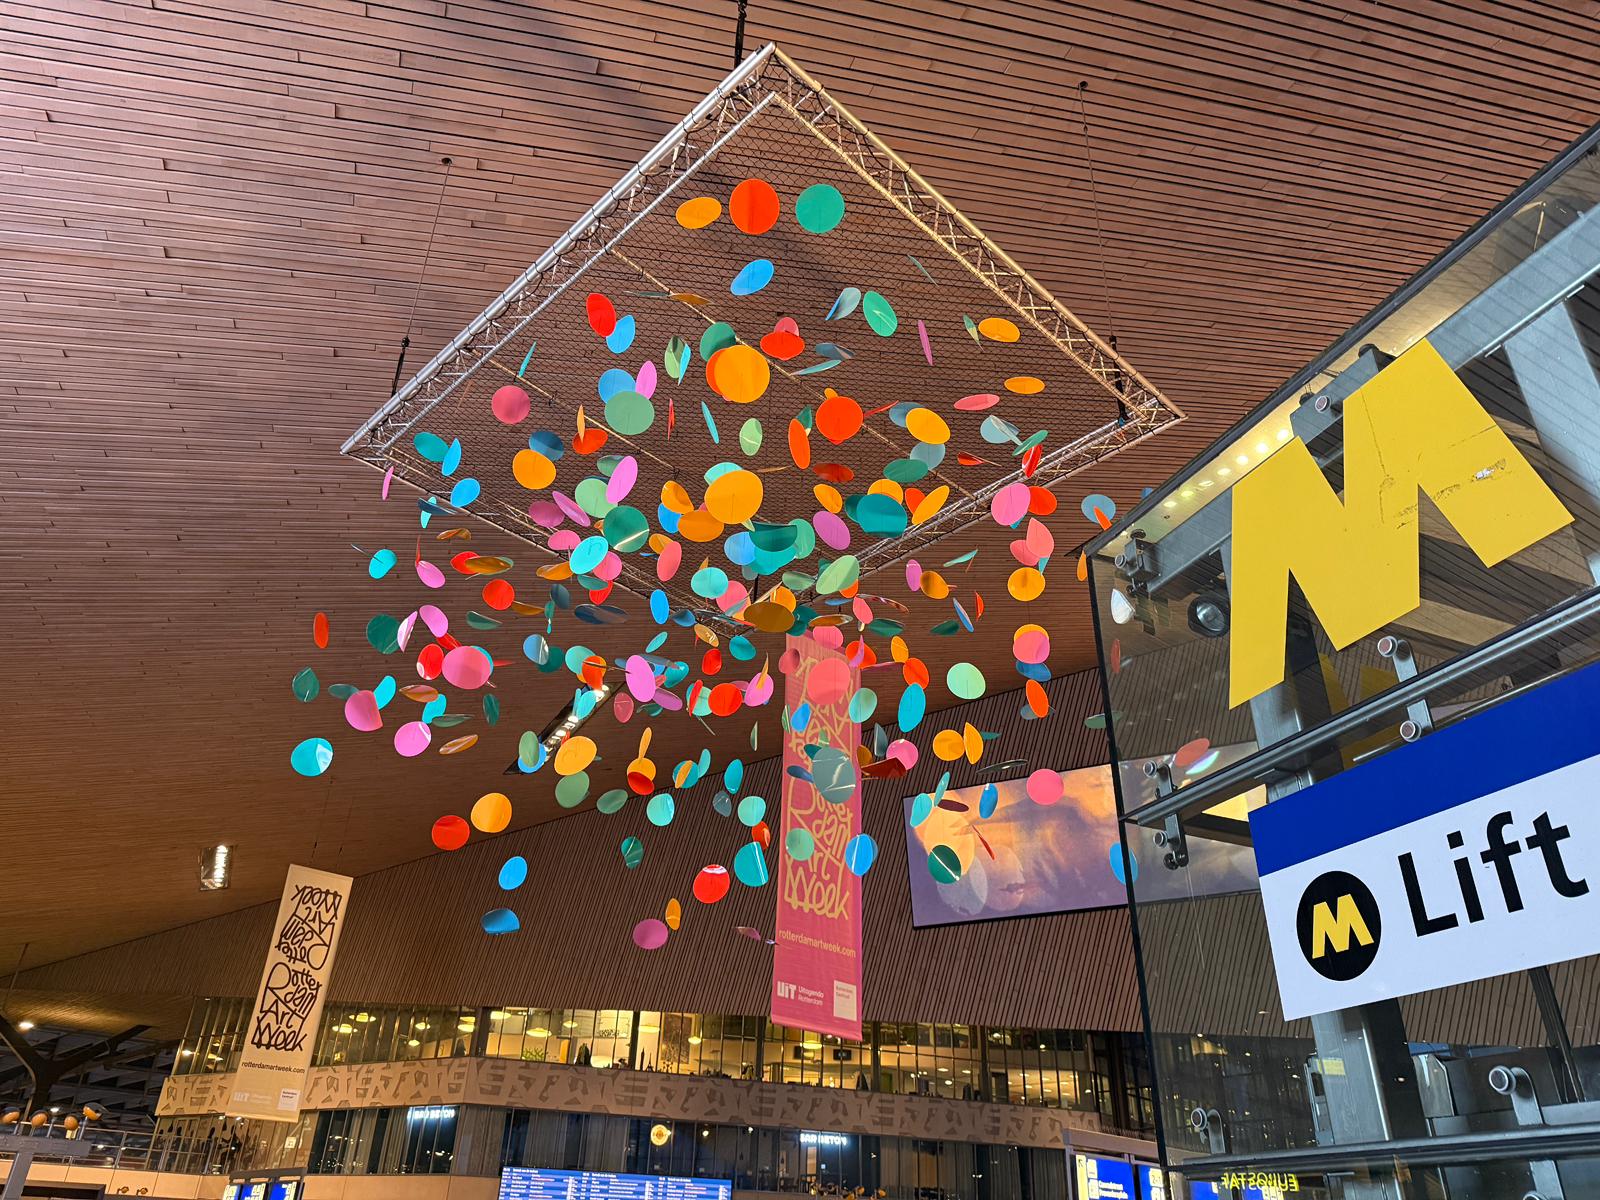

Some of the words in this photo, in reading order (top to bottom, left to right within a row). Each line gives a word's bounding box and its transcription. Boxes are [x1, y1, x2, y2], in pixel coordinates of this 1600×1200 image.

[784, 854, 850, 920] Week
[1398, 811, 1590, 937] Lift
[778, 928, 856, 958] rotterdamartweek.com
[260, 1000, 302, 1029] Art
[251, 1016, 307, 1051] Week
[241, 1061, 306, 1075] rotterdamartweek.com
